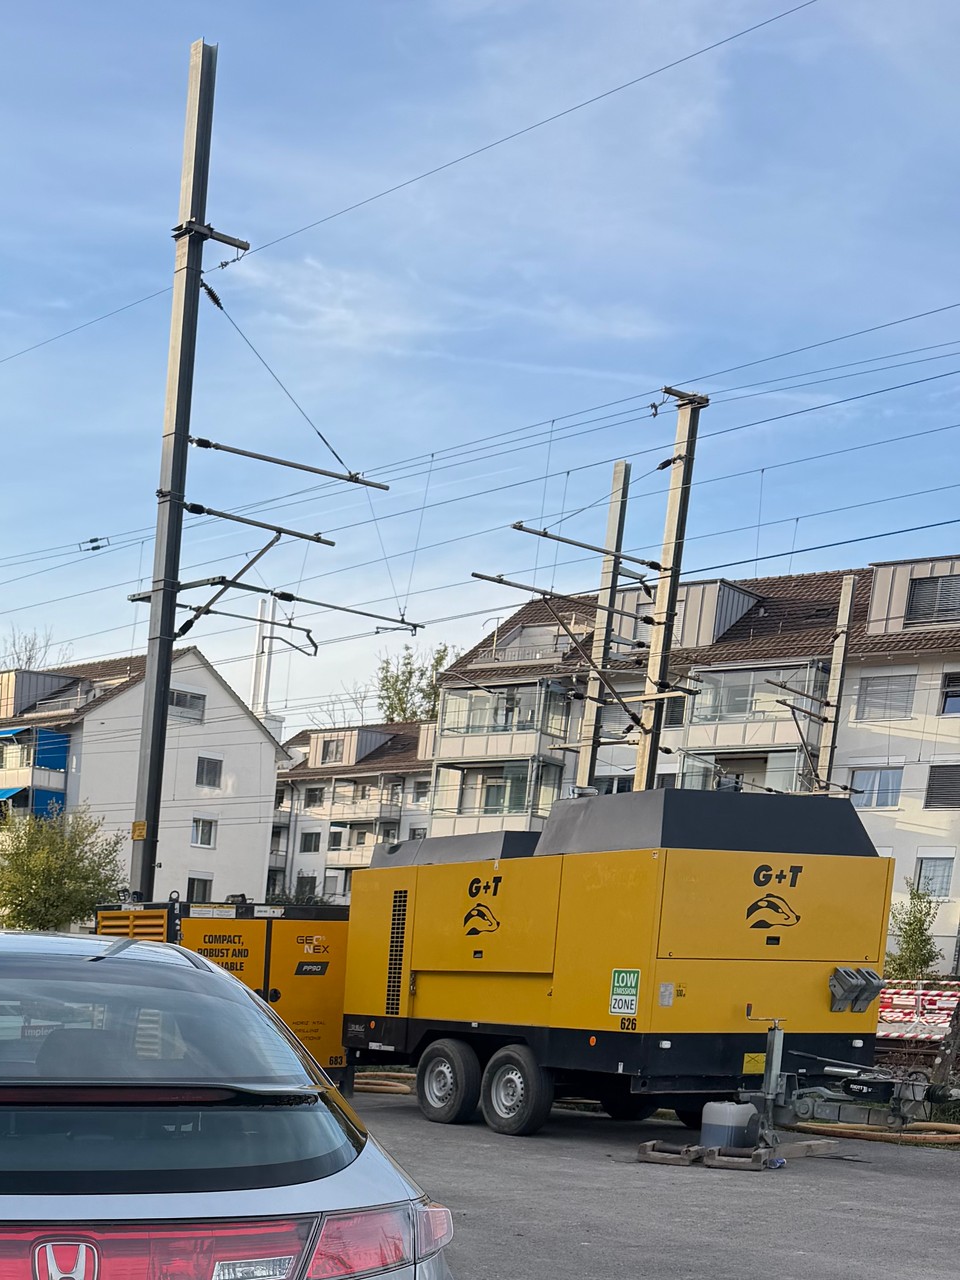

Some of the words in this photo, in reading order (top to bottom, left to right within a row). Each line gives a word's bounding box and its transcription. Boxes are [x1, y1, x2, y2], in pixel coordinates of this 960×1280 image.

[753, 864, 803, 888] G+T
[468, 876, 502, 898] G+T
[203, 934, 244, 946] COMPACT,
[231, 948, 249, 958] AND
[217, 961, 244, 972] IABLE
[614, 972, 638, 987] LOW
[613, 987, 637, 995] EMISSION
[612, 998, 635, 1011] ZONE
[620, 1017, 637, 1031] 626
[329, 1056, 344, 1066] 683
